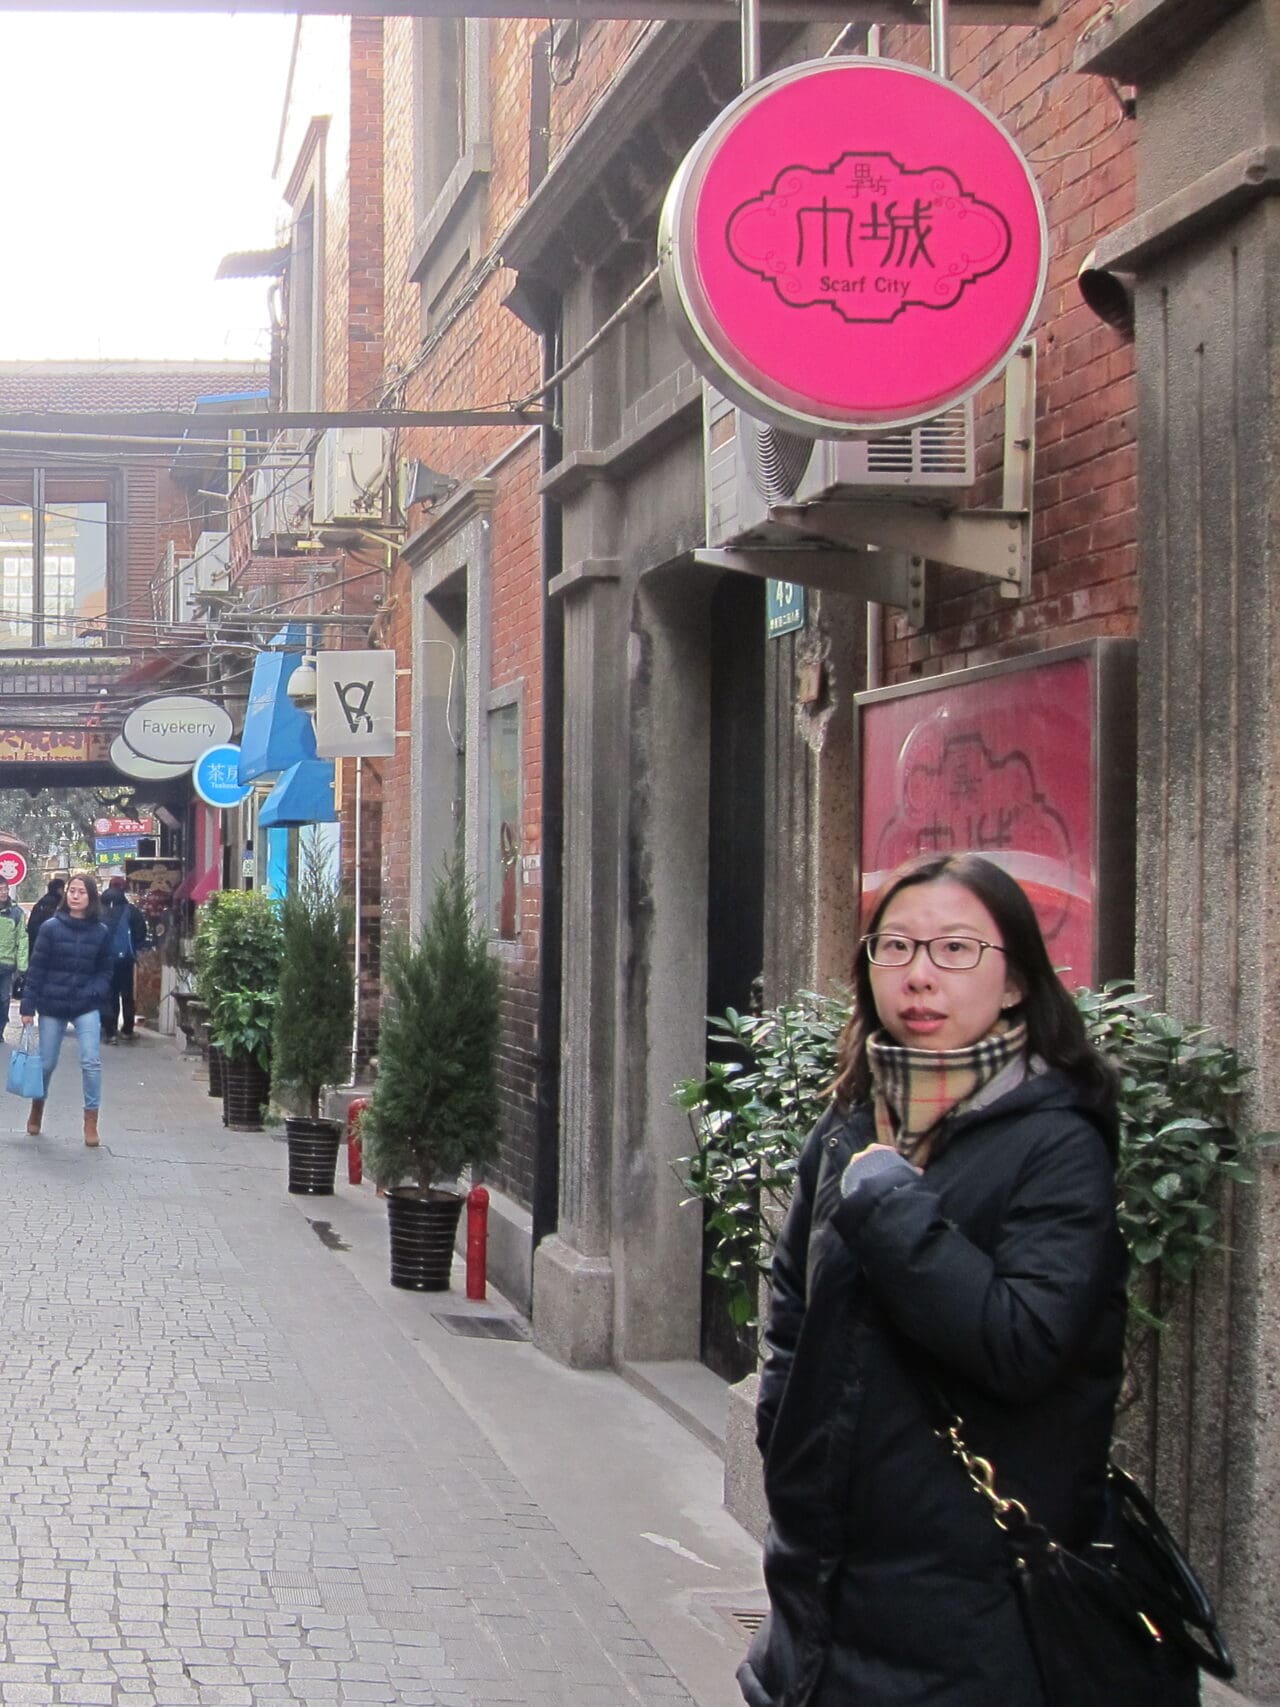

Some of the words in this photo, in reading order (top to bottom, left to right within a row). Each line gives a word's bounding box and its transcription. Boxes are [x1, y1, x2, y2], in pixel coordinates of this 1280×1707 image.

[797, 196, 936, 268] 巾城
[820, 276, 866, 293] Scarf
[875, 276, 910, 298] City
[143, 719, 215, 737] Fayekerry
